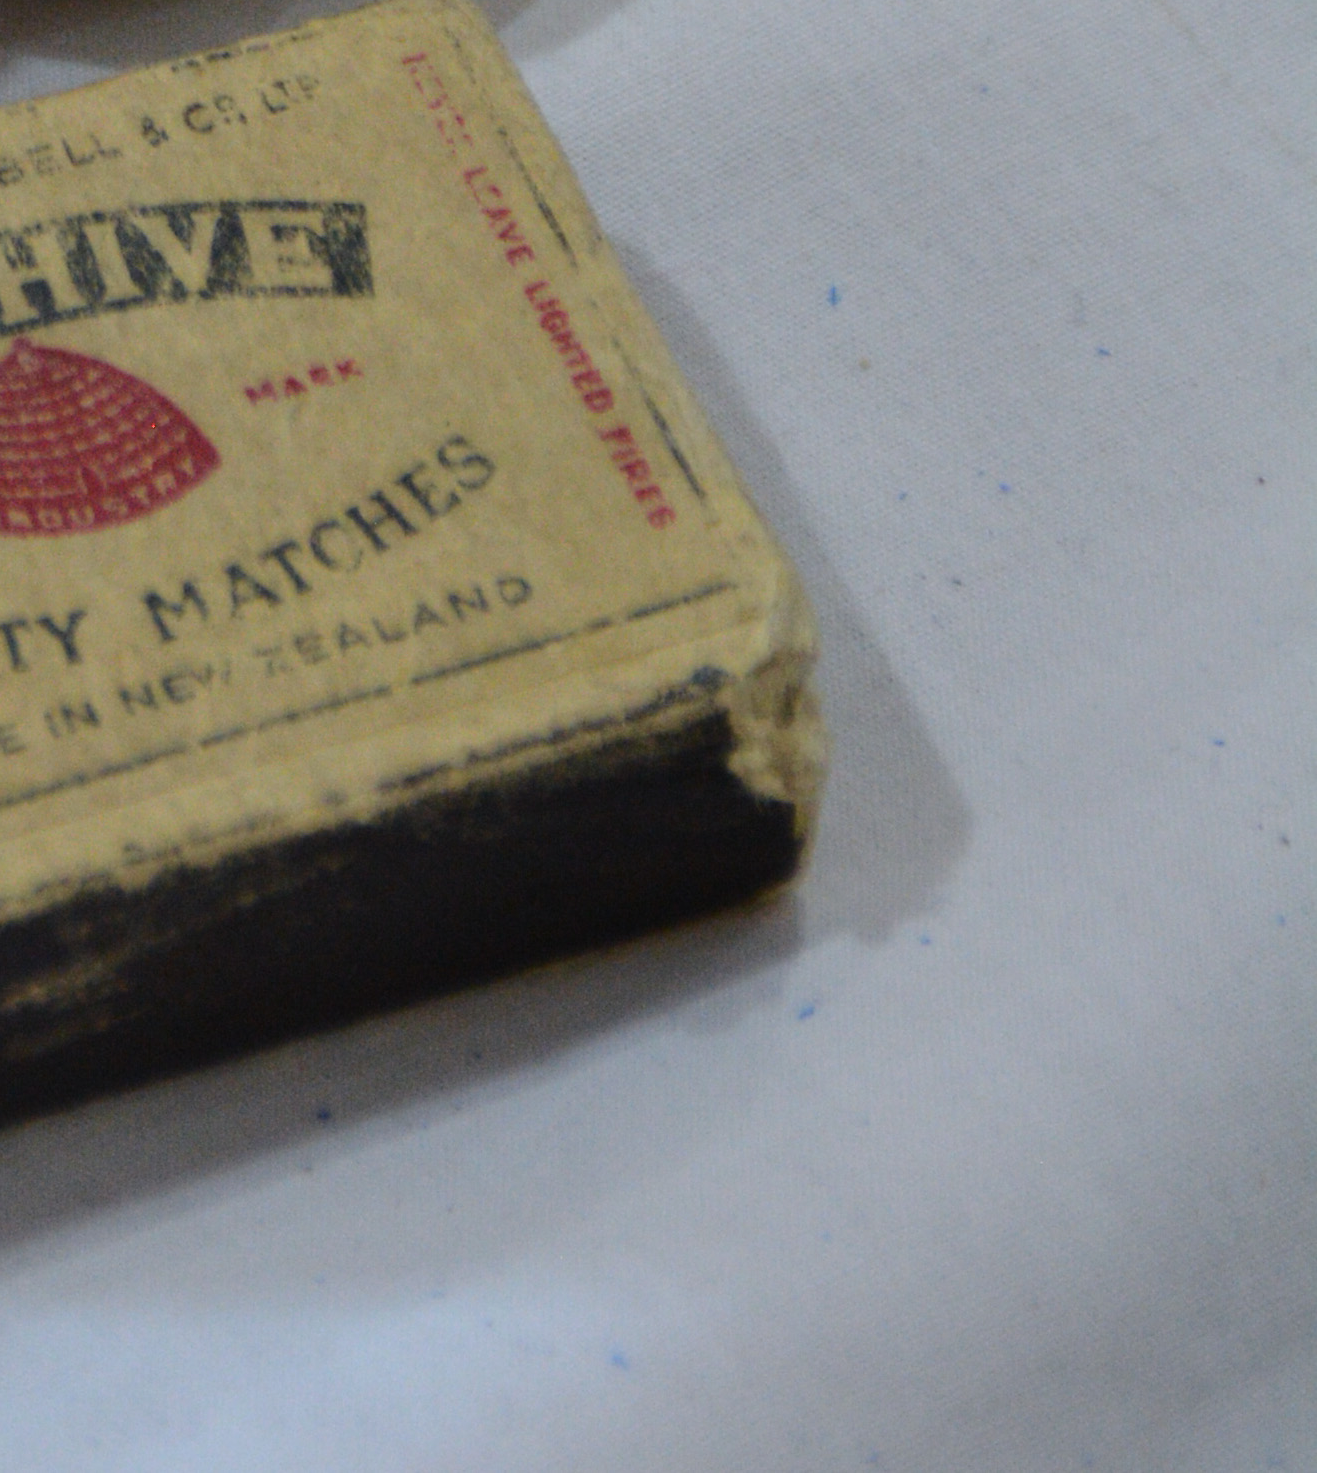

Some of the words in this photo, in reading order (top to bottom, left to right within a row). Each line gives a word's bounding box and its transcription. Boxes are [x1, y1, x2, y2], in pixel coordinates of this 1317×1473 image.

[140, 114, 170, 149] &
[244, 358, 364, 406] MARK
[523, 279, 615, 416] LIGHTED
[598, 423, 677, 532] FIRES
[137, 432, 498, 647] MATCHES
[44, 700, 103, 740] IN
[117, 662, 236, 718] NEW
[261, 574, 535, 680] ZEALAND
